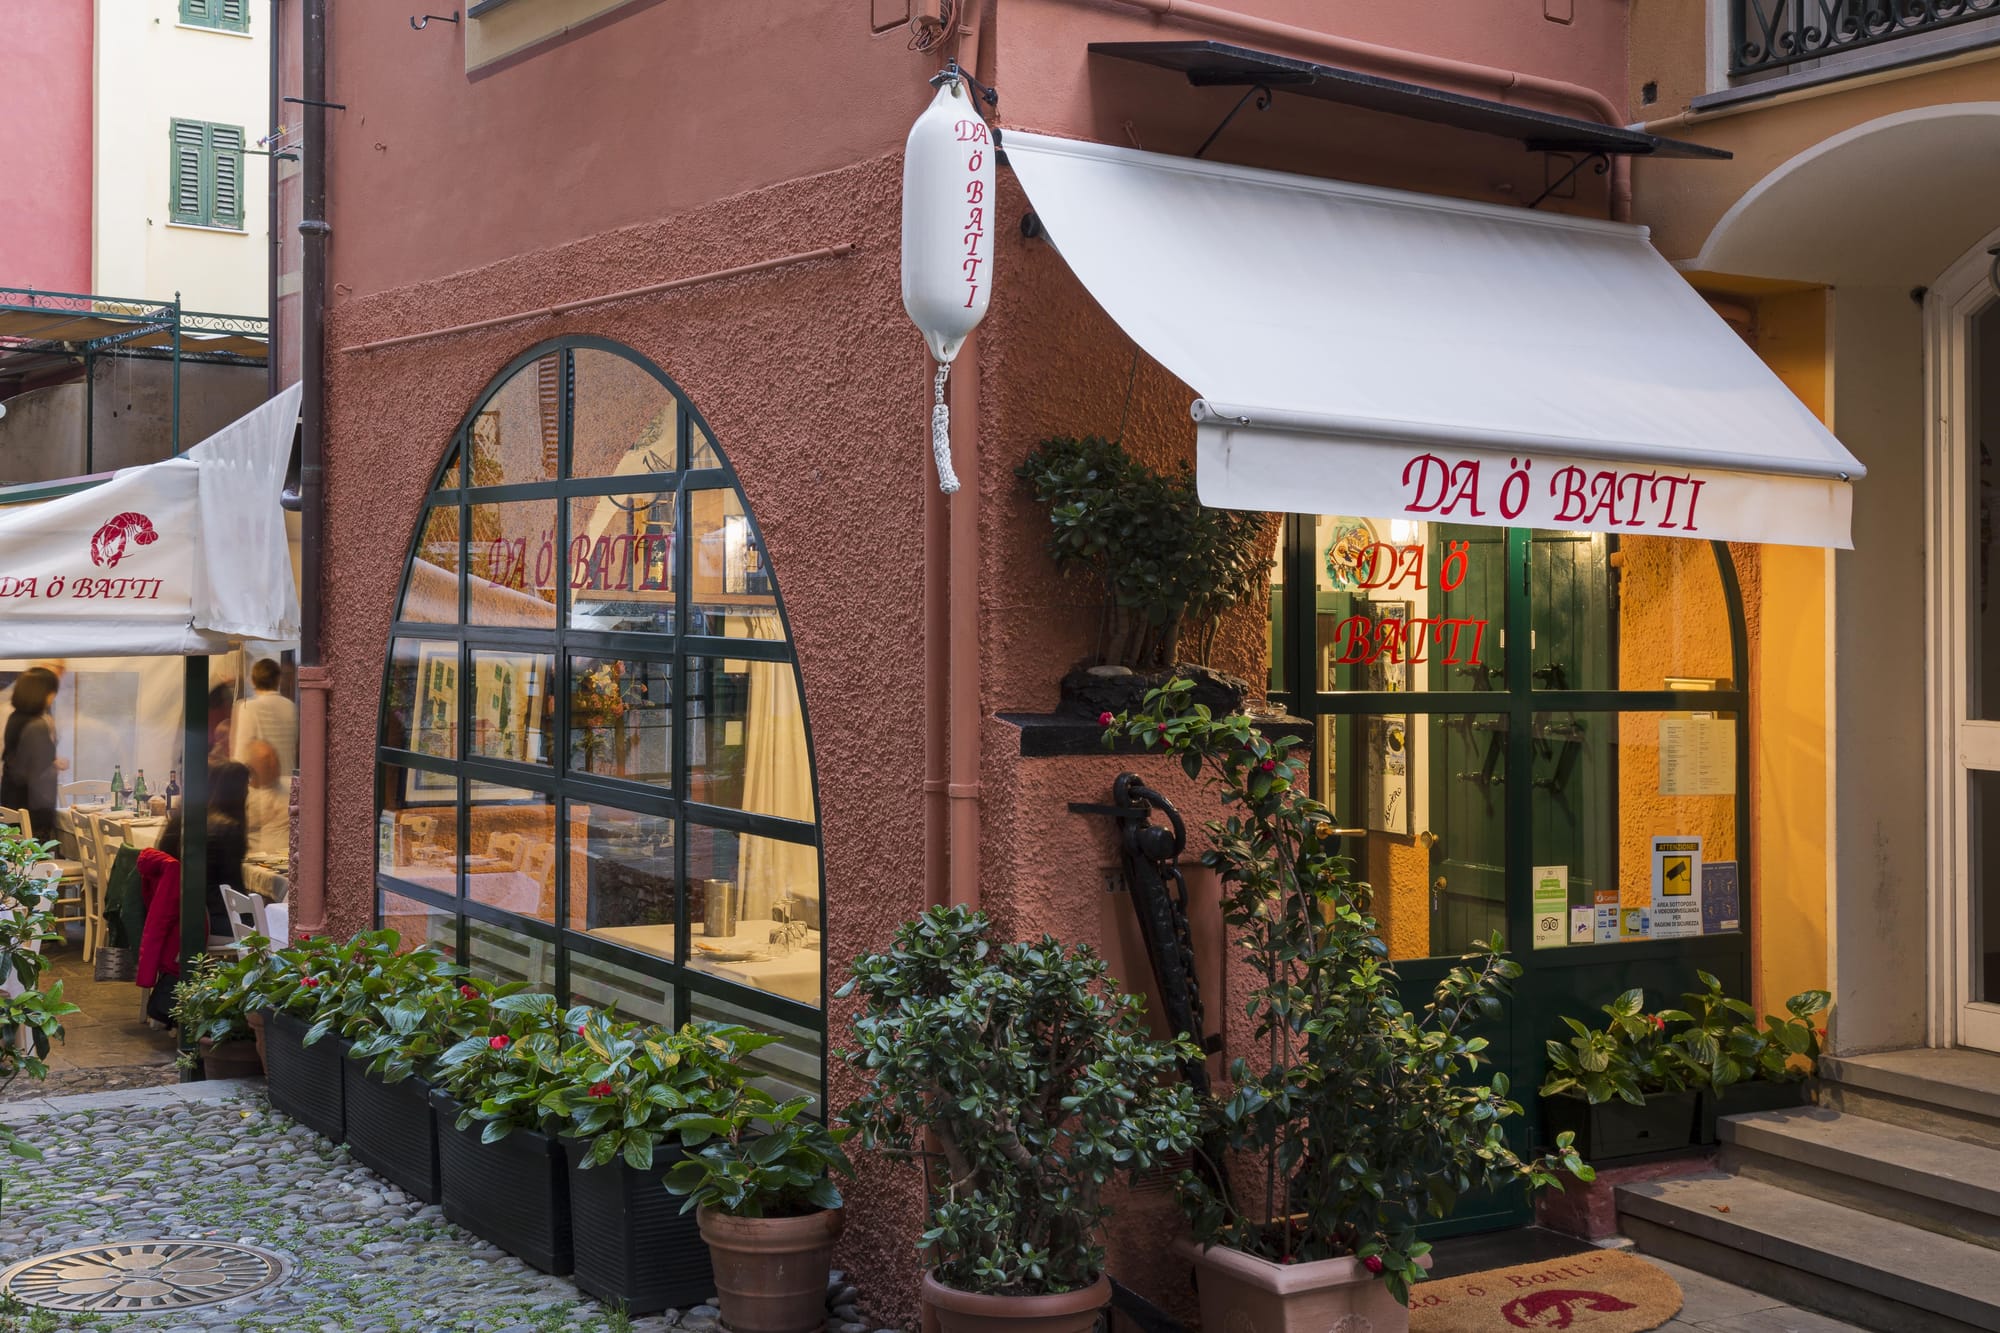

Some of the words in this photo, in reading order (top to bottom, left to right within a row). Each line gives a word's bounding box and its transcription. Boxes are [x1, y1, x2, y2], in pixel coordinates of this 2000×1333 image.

[953, 119, 989, 145] DA
[968, 150, 983, 172] Ö
[963, 180, 984, 308] BATTI
[1401, 452, 1486, 518] DA
[1499, 457, 1531, 520] Ö
[1550, 465, 1706, 531] BATTI
[487, 535, 528, 588] DA
[535, 530, 554, 588] Ö
[568, 529, 675, 591] BATTI
[1357, 540, 1428, 591] DA
[1439, 540, 1469, 592] Ö
[0, 576, 38, 599] DA
[46, 575, 66, 598] Ö
[72, 576, 164, 600] BATTI
[1334, 614, 1489, 666] BATTI
